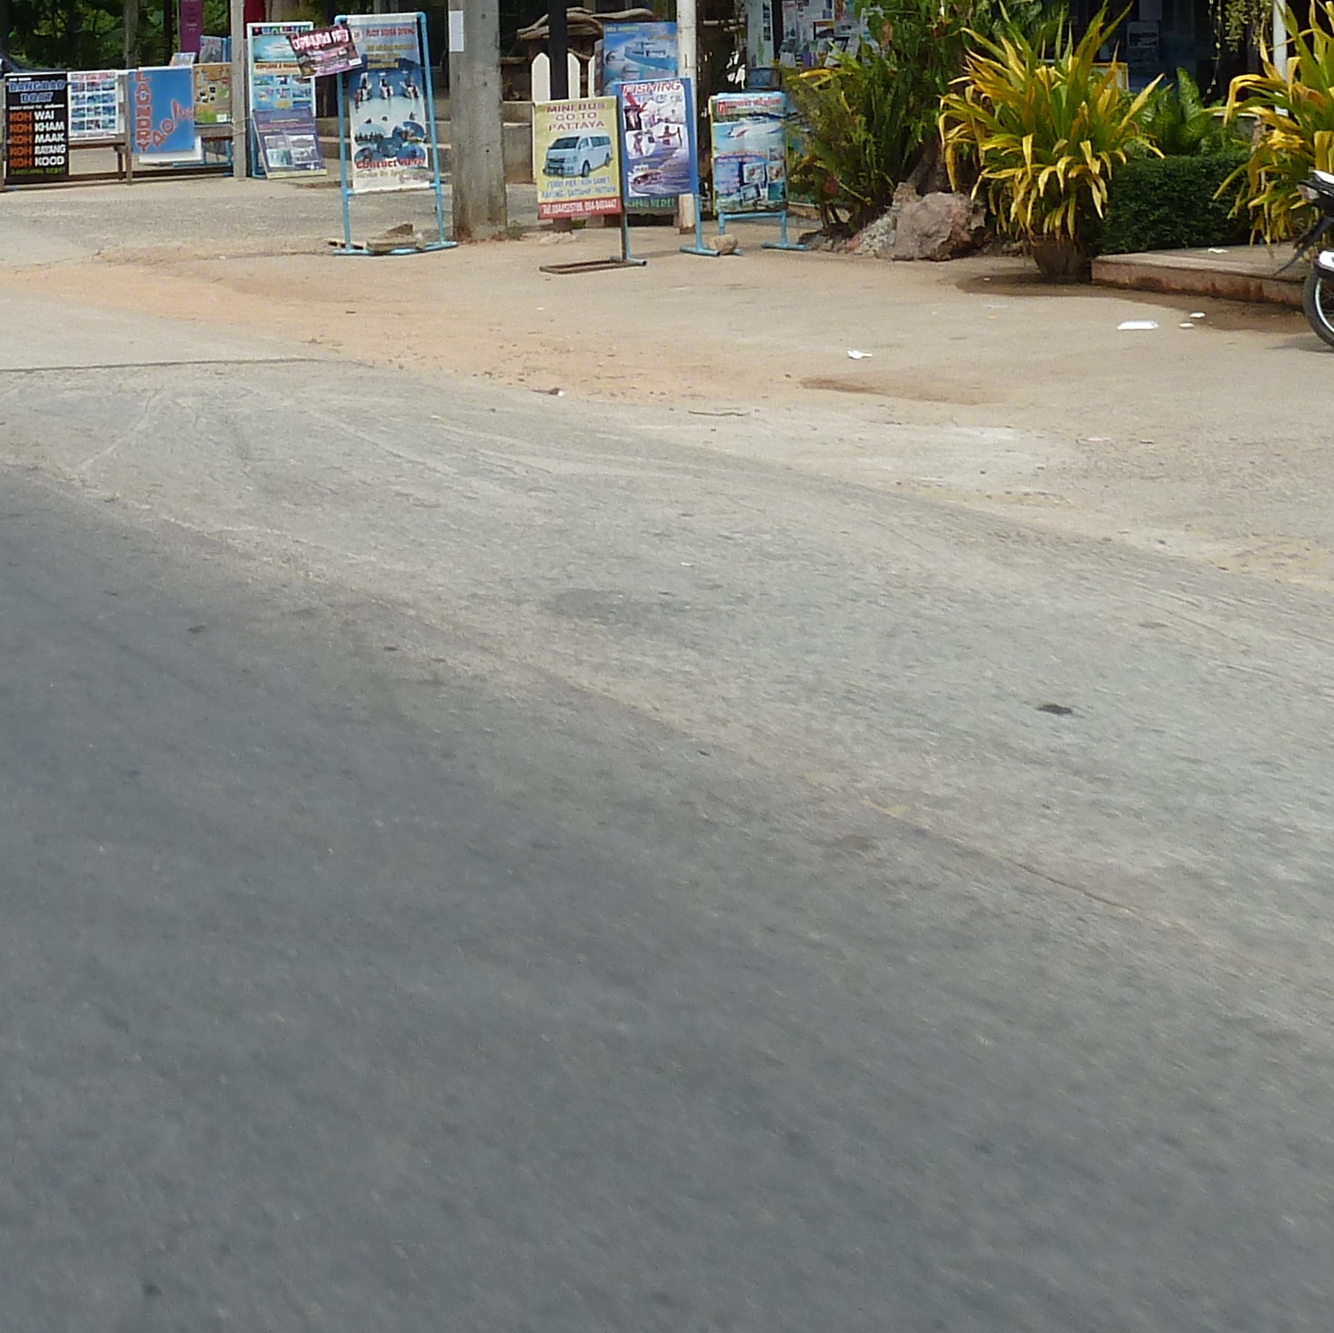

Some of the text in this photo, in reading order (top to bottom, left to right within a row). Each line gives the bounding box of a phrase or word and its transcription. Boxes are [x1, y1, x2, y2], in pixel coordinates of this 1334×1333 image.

[622, 79, 681, 96] FISHING
[133, 71, 152, 152] LAUNDRY
[546, 102, 606, 113] MINI BUS
[34, 111, 55, 121] WAI
[555, 112, 598, 122] GO TO
[9, 122, 65, 133] KOH KHAM
[548, 121, 605, 132] PATTAYA
[9, 133, 65, 144] KOH MAAK
[9, 147, 32, 156] KOH
[9, 156, 65, 168] KOH KOOD
